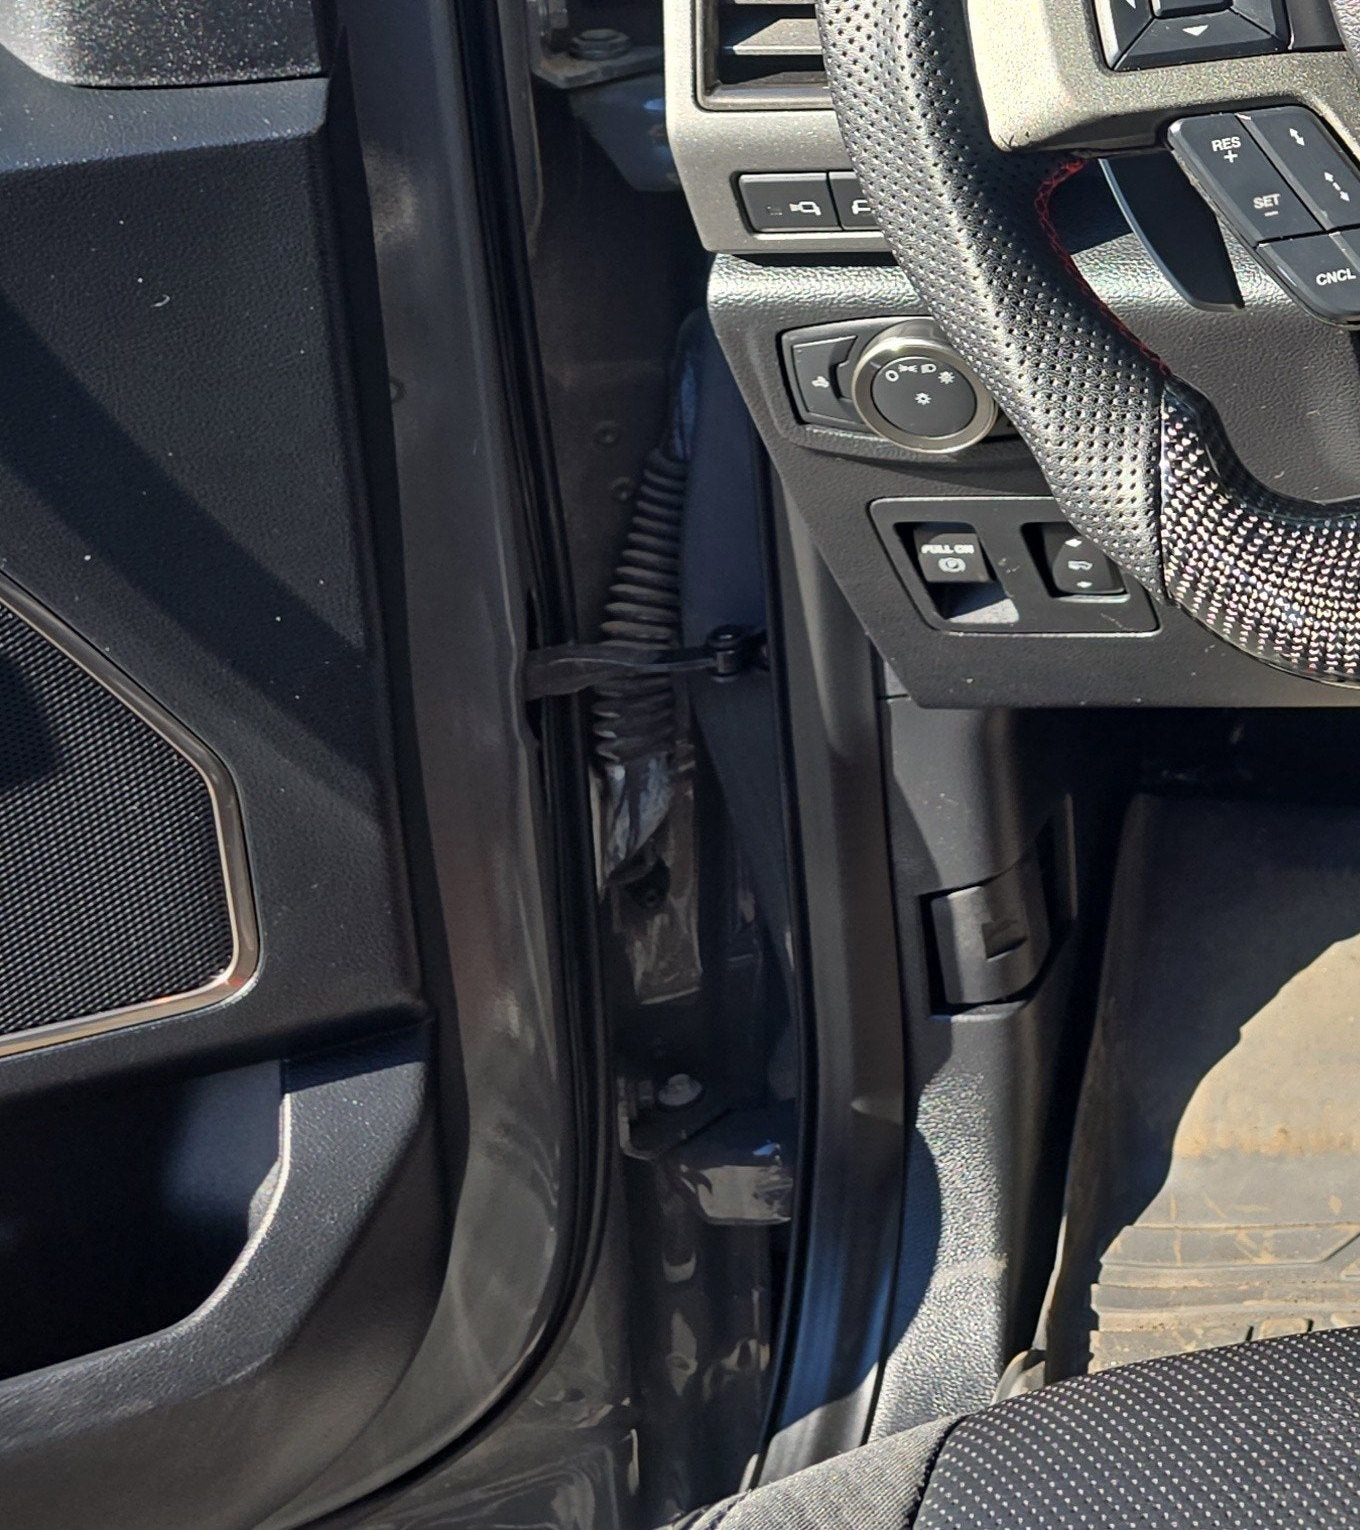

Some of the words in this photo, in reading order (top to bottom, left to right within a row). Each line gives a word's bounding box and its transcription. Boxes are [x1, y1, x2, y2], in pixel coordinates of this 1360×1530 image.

[1211, 136, 1242, 152] RES
[1253, 193, 1280, 209] SET
[1315, 268, 1357, 286] CNCL
